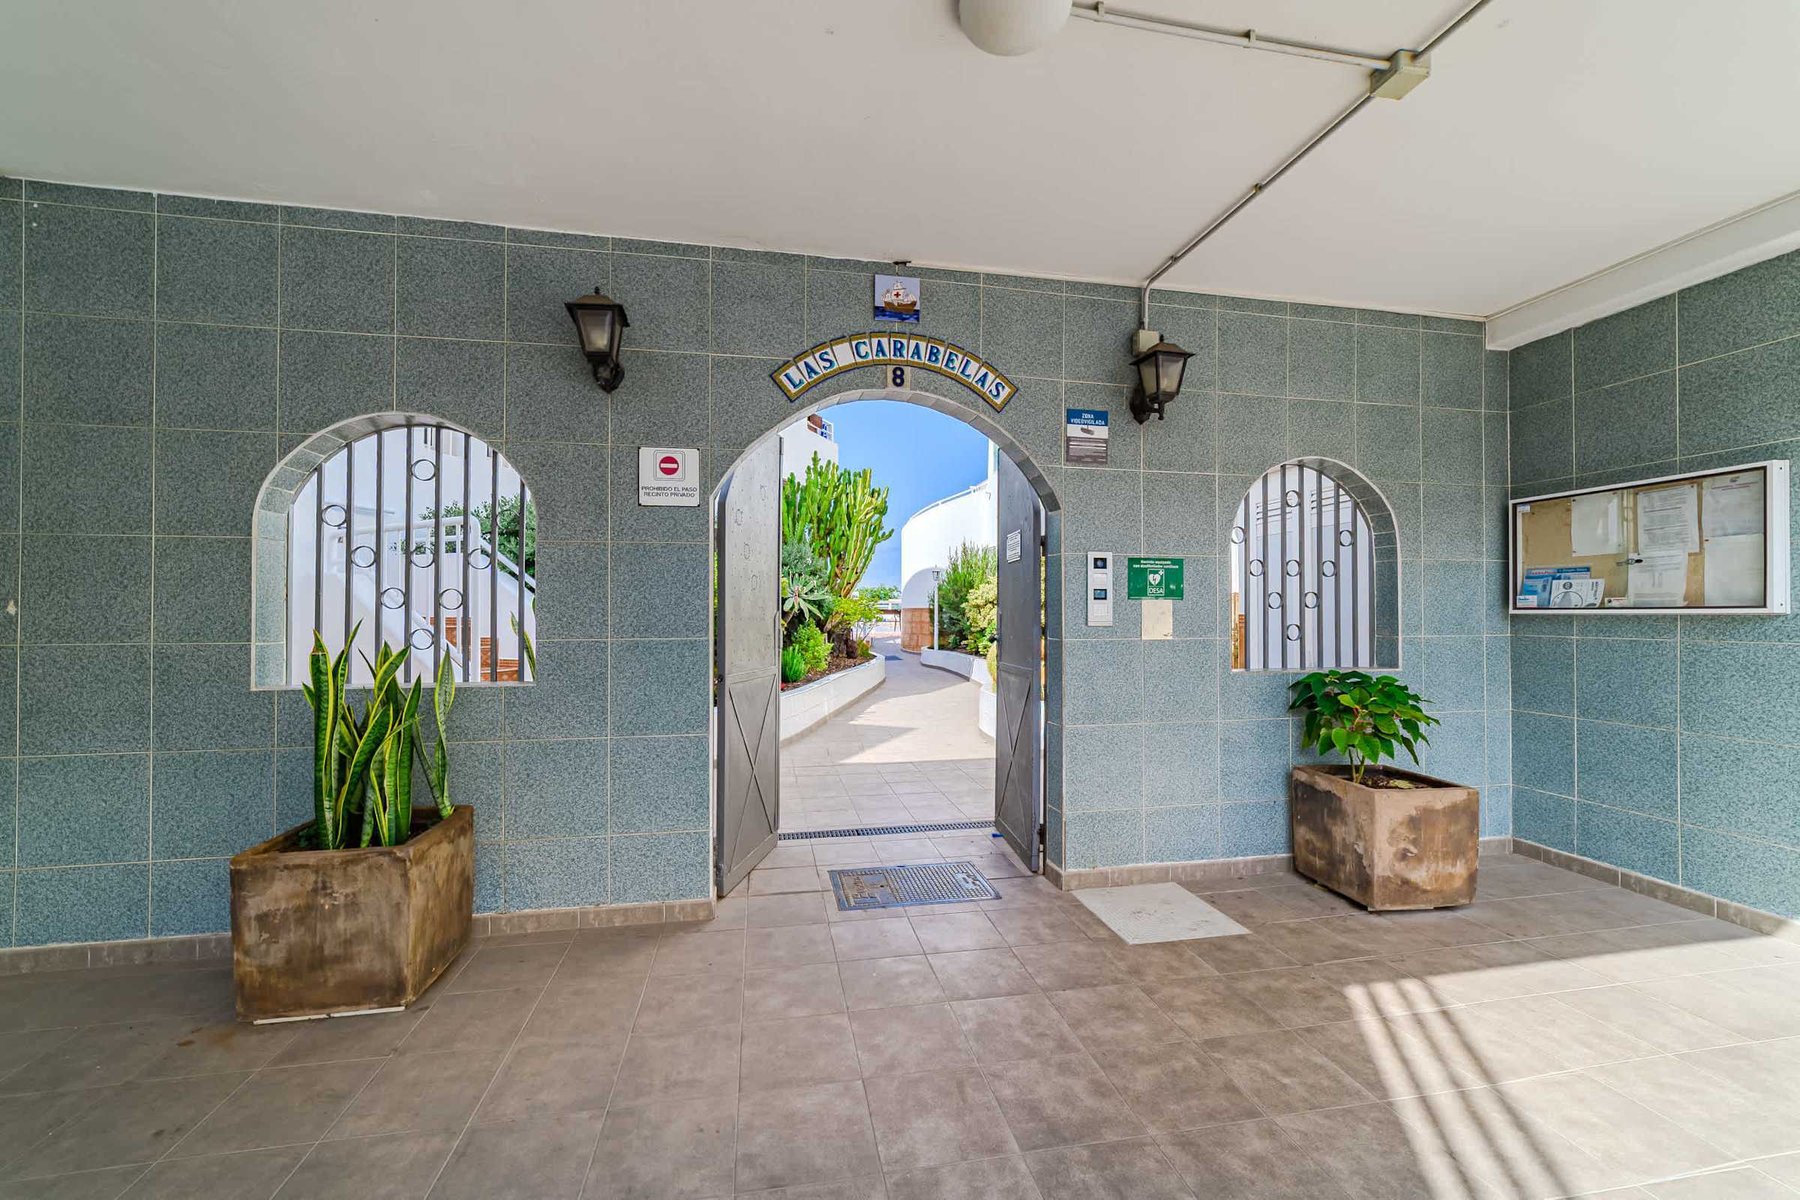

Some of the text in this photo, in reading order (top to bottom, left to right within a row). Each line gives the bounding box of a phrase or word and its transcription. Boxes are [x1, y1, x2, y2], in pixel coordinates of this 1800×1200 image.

[783, 339, 1006, 400] LAS CARABELAS
[892, 366, 905, 388] 8
